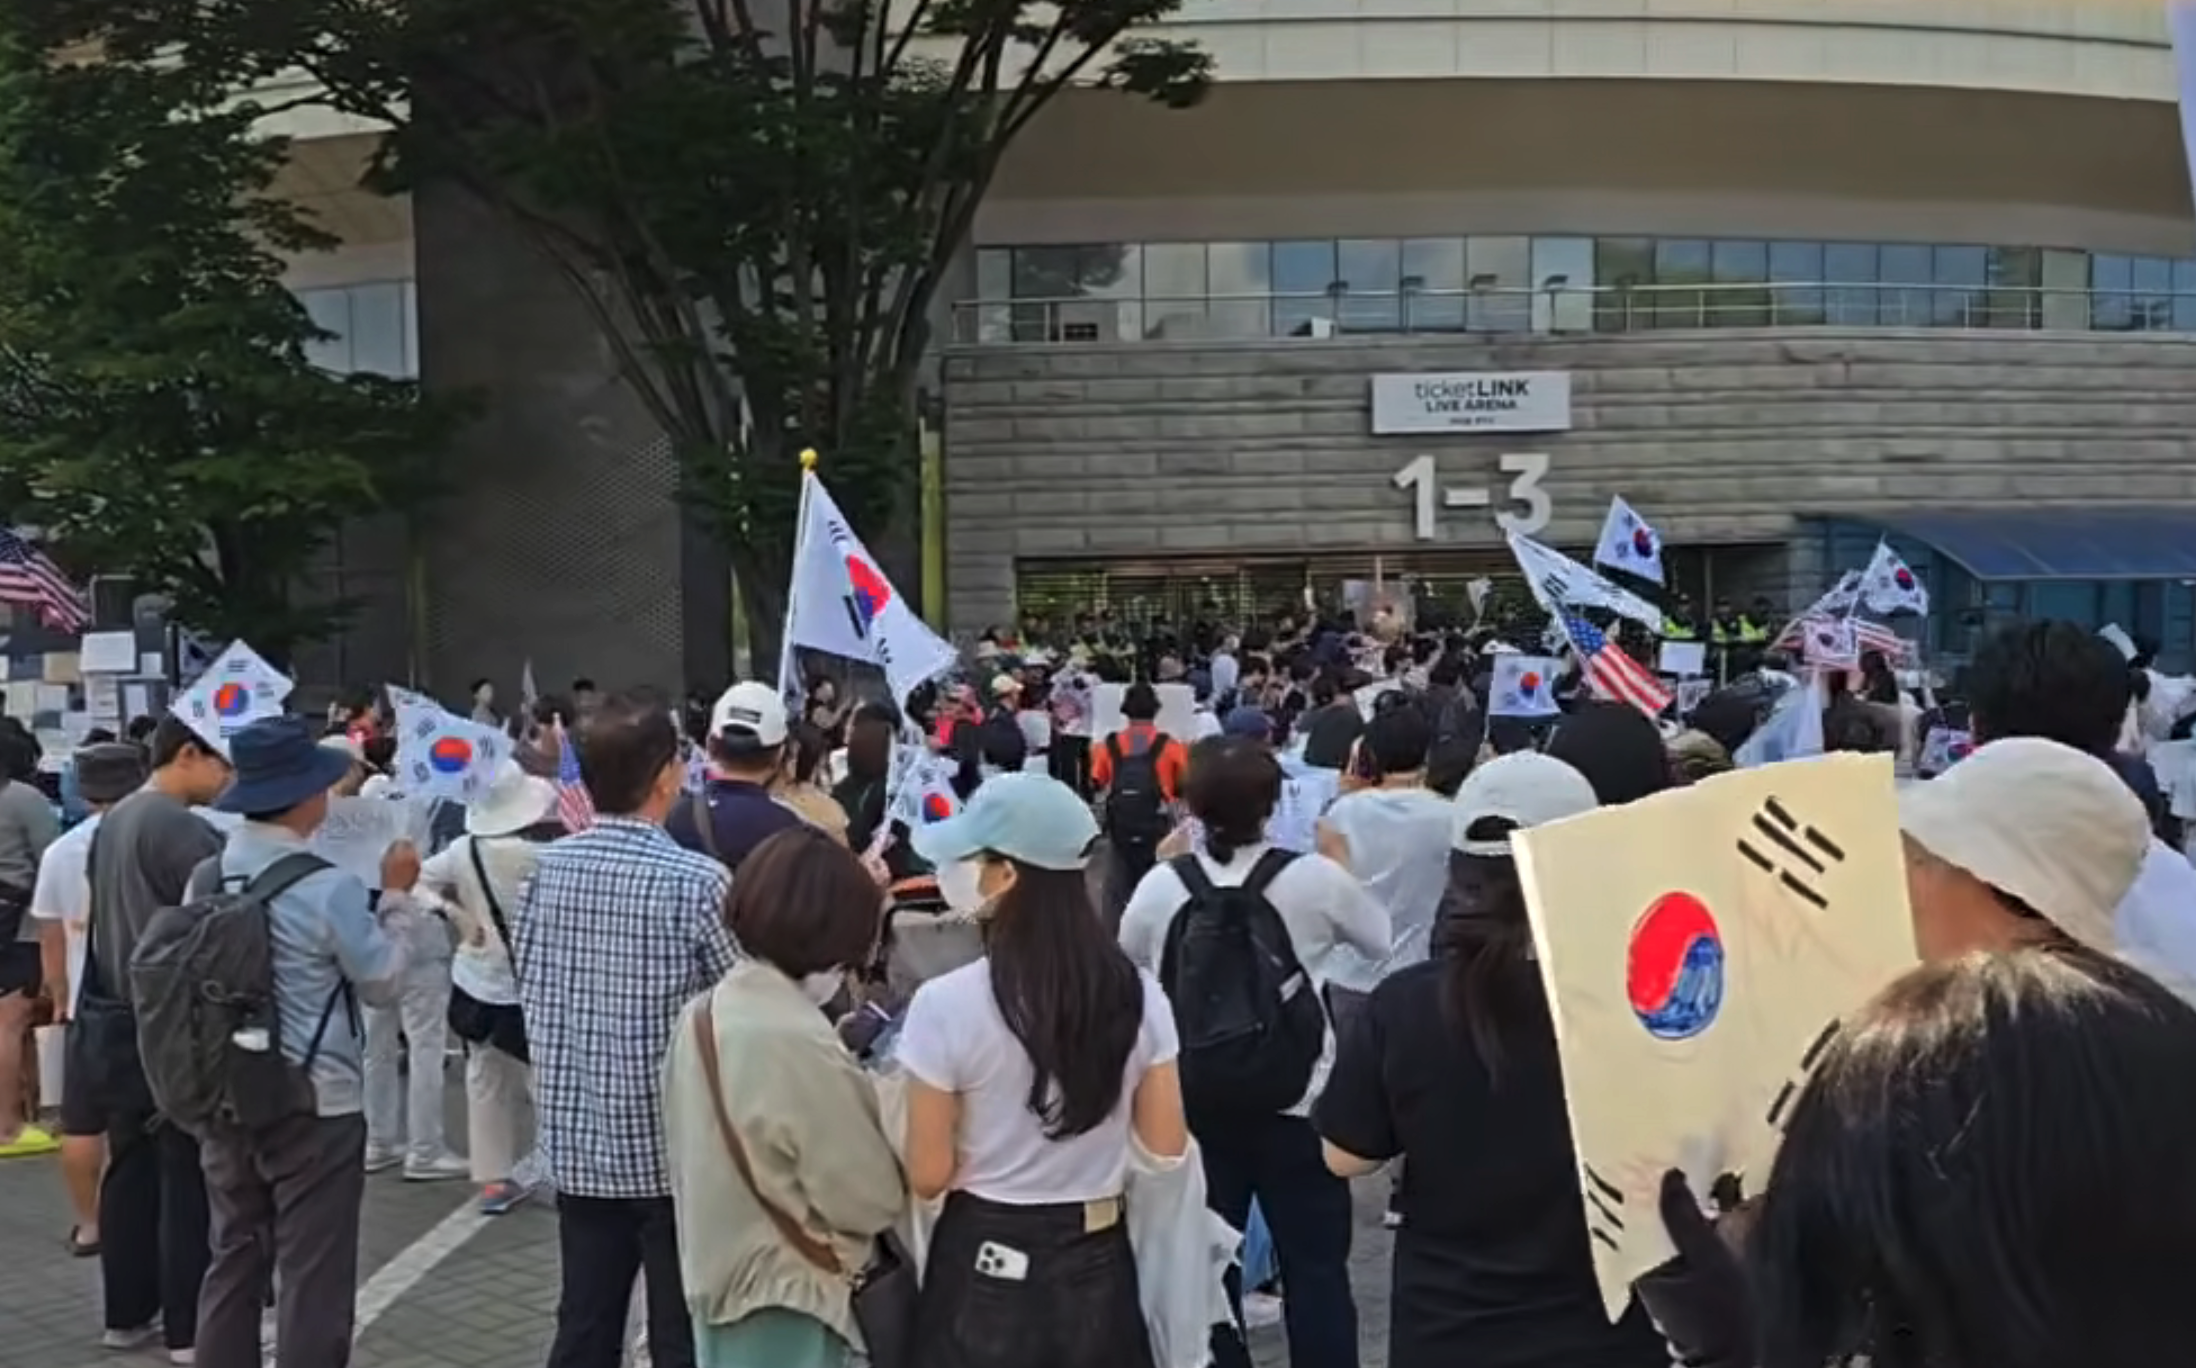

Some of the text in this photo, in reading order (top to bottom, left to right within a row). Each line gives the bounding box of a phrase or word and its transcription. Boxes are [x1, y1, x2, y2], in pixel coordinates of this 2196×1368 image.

[1415, 380, 1530, 399] ticketLINK
[1426, 399, 1517, 413] LIVE ARENA
[1393, 454, 1552, 539] 1-3
